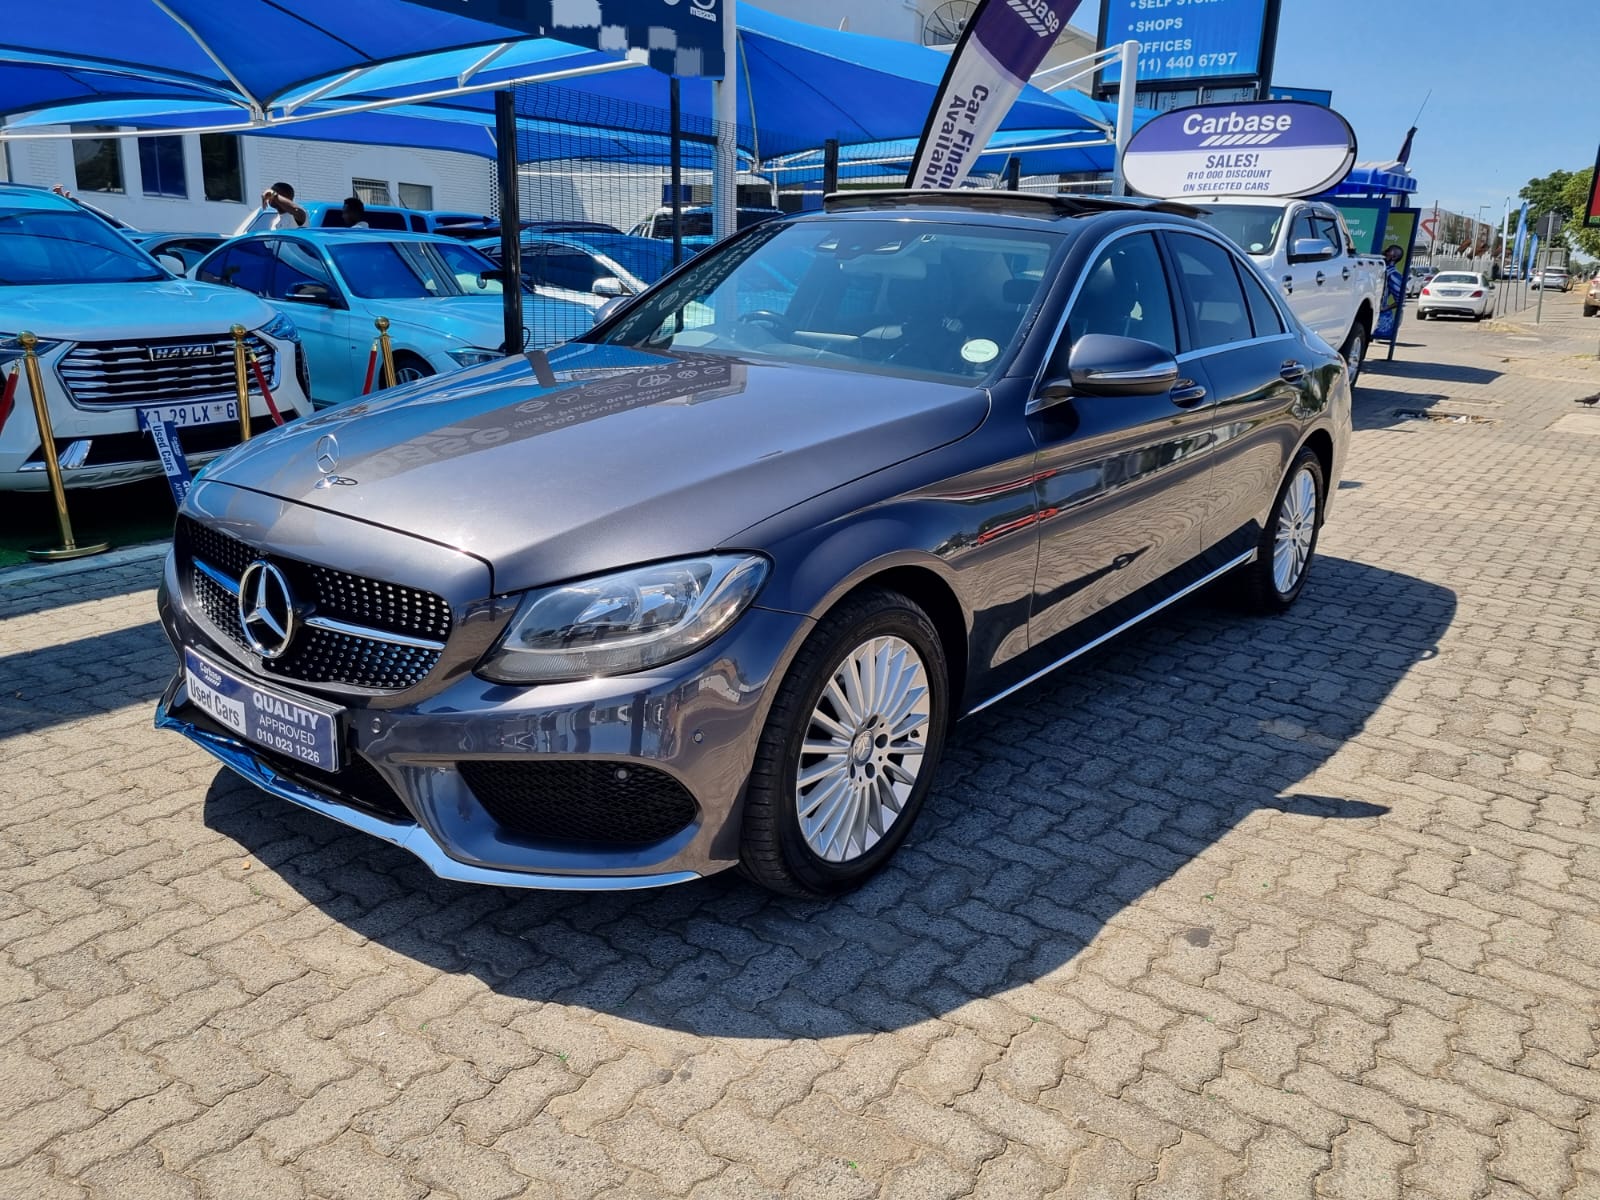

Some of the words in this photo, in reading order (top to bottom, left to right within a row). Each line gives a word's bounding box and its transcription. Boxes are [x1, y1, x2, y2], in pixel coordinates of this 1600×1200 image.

[1135, 17, 1183, 33] SHOPS
[1165, 55, 1195, 70] 440
[1198, 51, 1238, 68] 6797
[964, 84, 989, 125] Car
[1183, 111, 1292, 136] Carbase
[1205, 153, 1260, 169] SALES!
[1183, 183, 1196, 192] ON
[1197, 182, 1242, 192] SELECTED
[1244, 182, 1271, 191] CARS
[1187, 171, 1205, 180] R10
[1206, 170, 1224, 179] 000
[1225, 169, 1273, 179] DISCOUNT
[192, 405, 210, 422] LX
[153, 425, 169, 448] Used
[161, 450, 175, 472] Cars
[190, 677, 213, 711] Used
[214, 695, 240, 727] Cars
[252, 691, 319, 730] QUALITY
[259, 713, 316, 746] APPROVED
[256, 727, 274, 745] 010
[275, 736, 293, 753] 023
[296, 744, 320, 763] 1226
